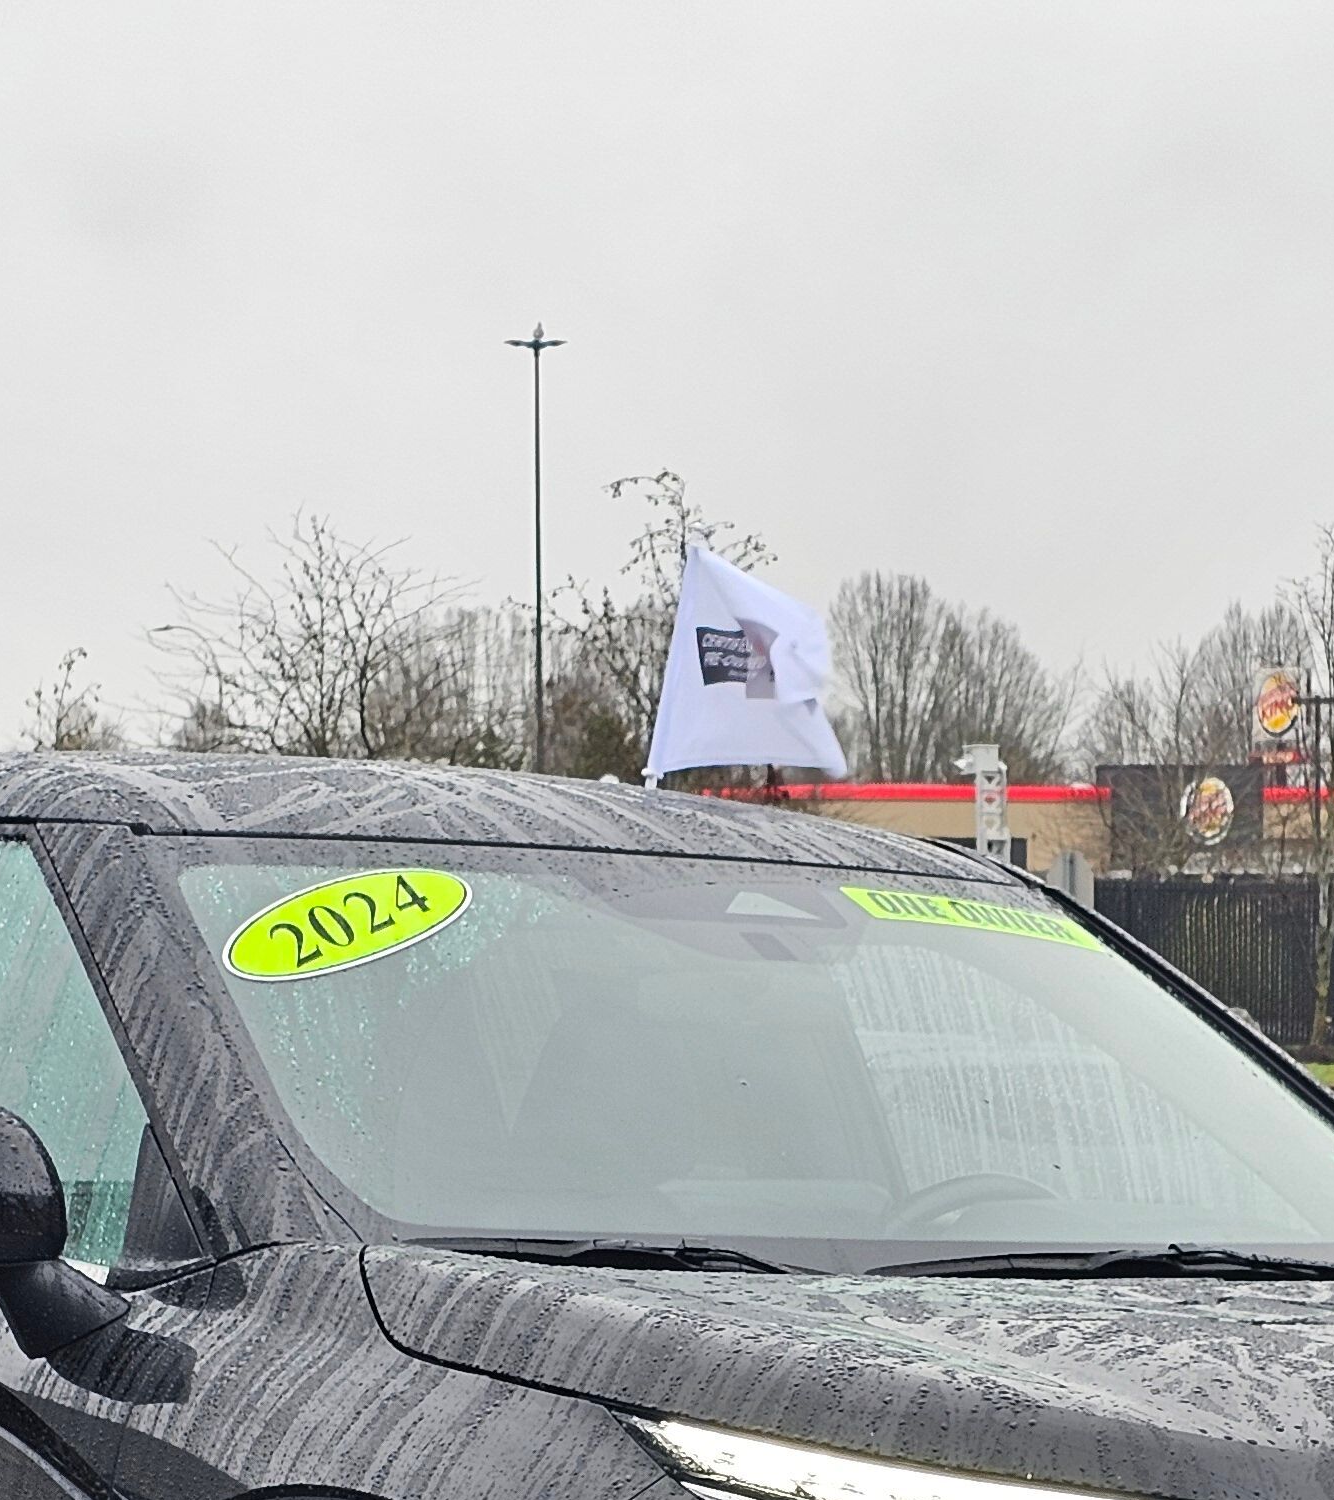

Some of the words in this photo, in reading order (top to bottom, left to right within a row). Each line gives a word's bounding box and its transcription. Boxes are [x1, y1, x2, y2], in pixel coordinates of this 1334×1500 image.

[269, 875, 429, 968] 2024
[867, 891, 949, 919] ONE
[947, 900, 1077, 941] OWNER
